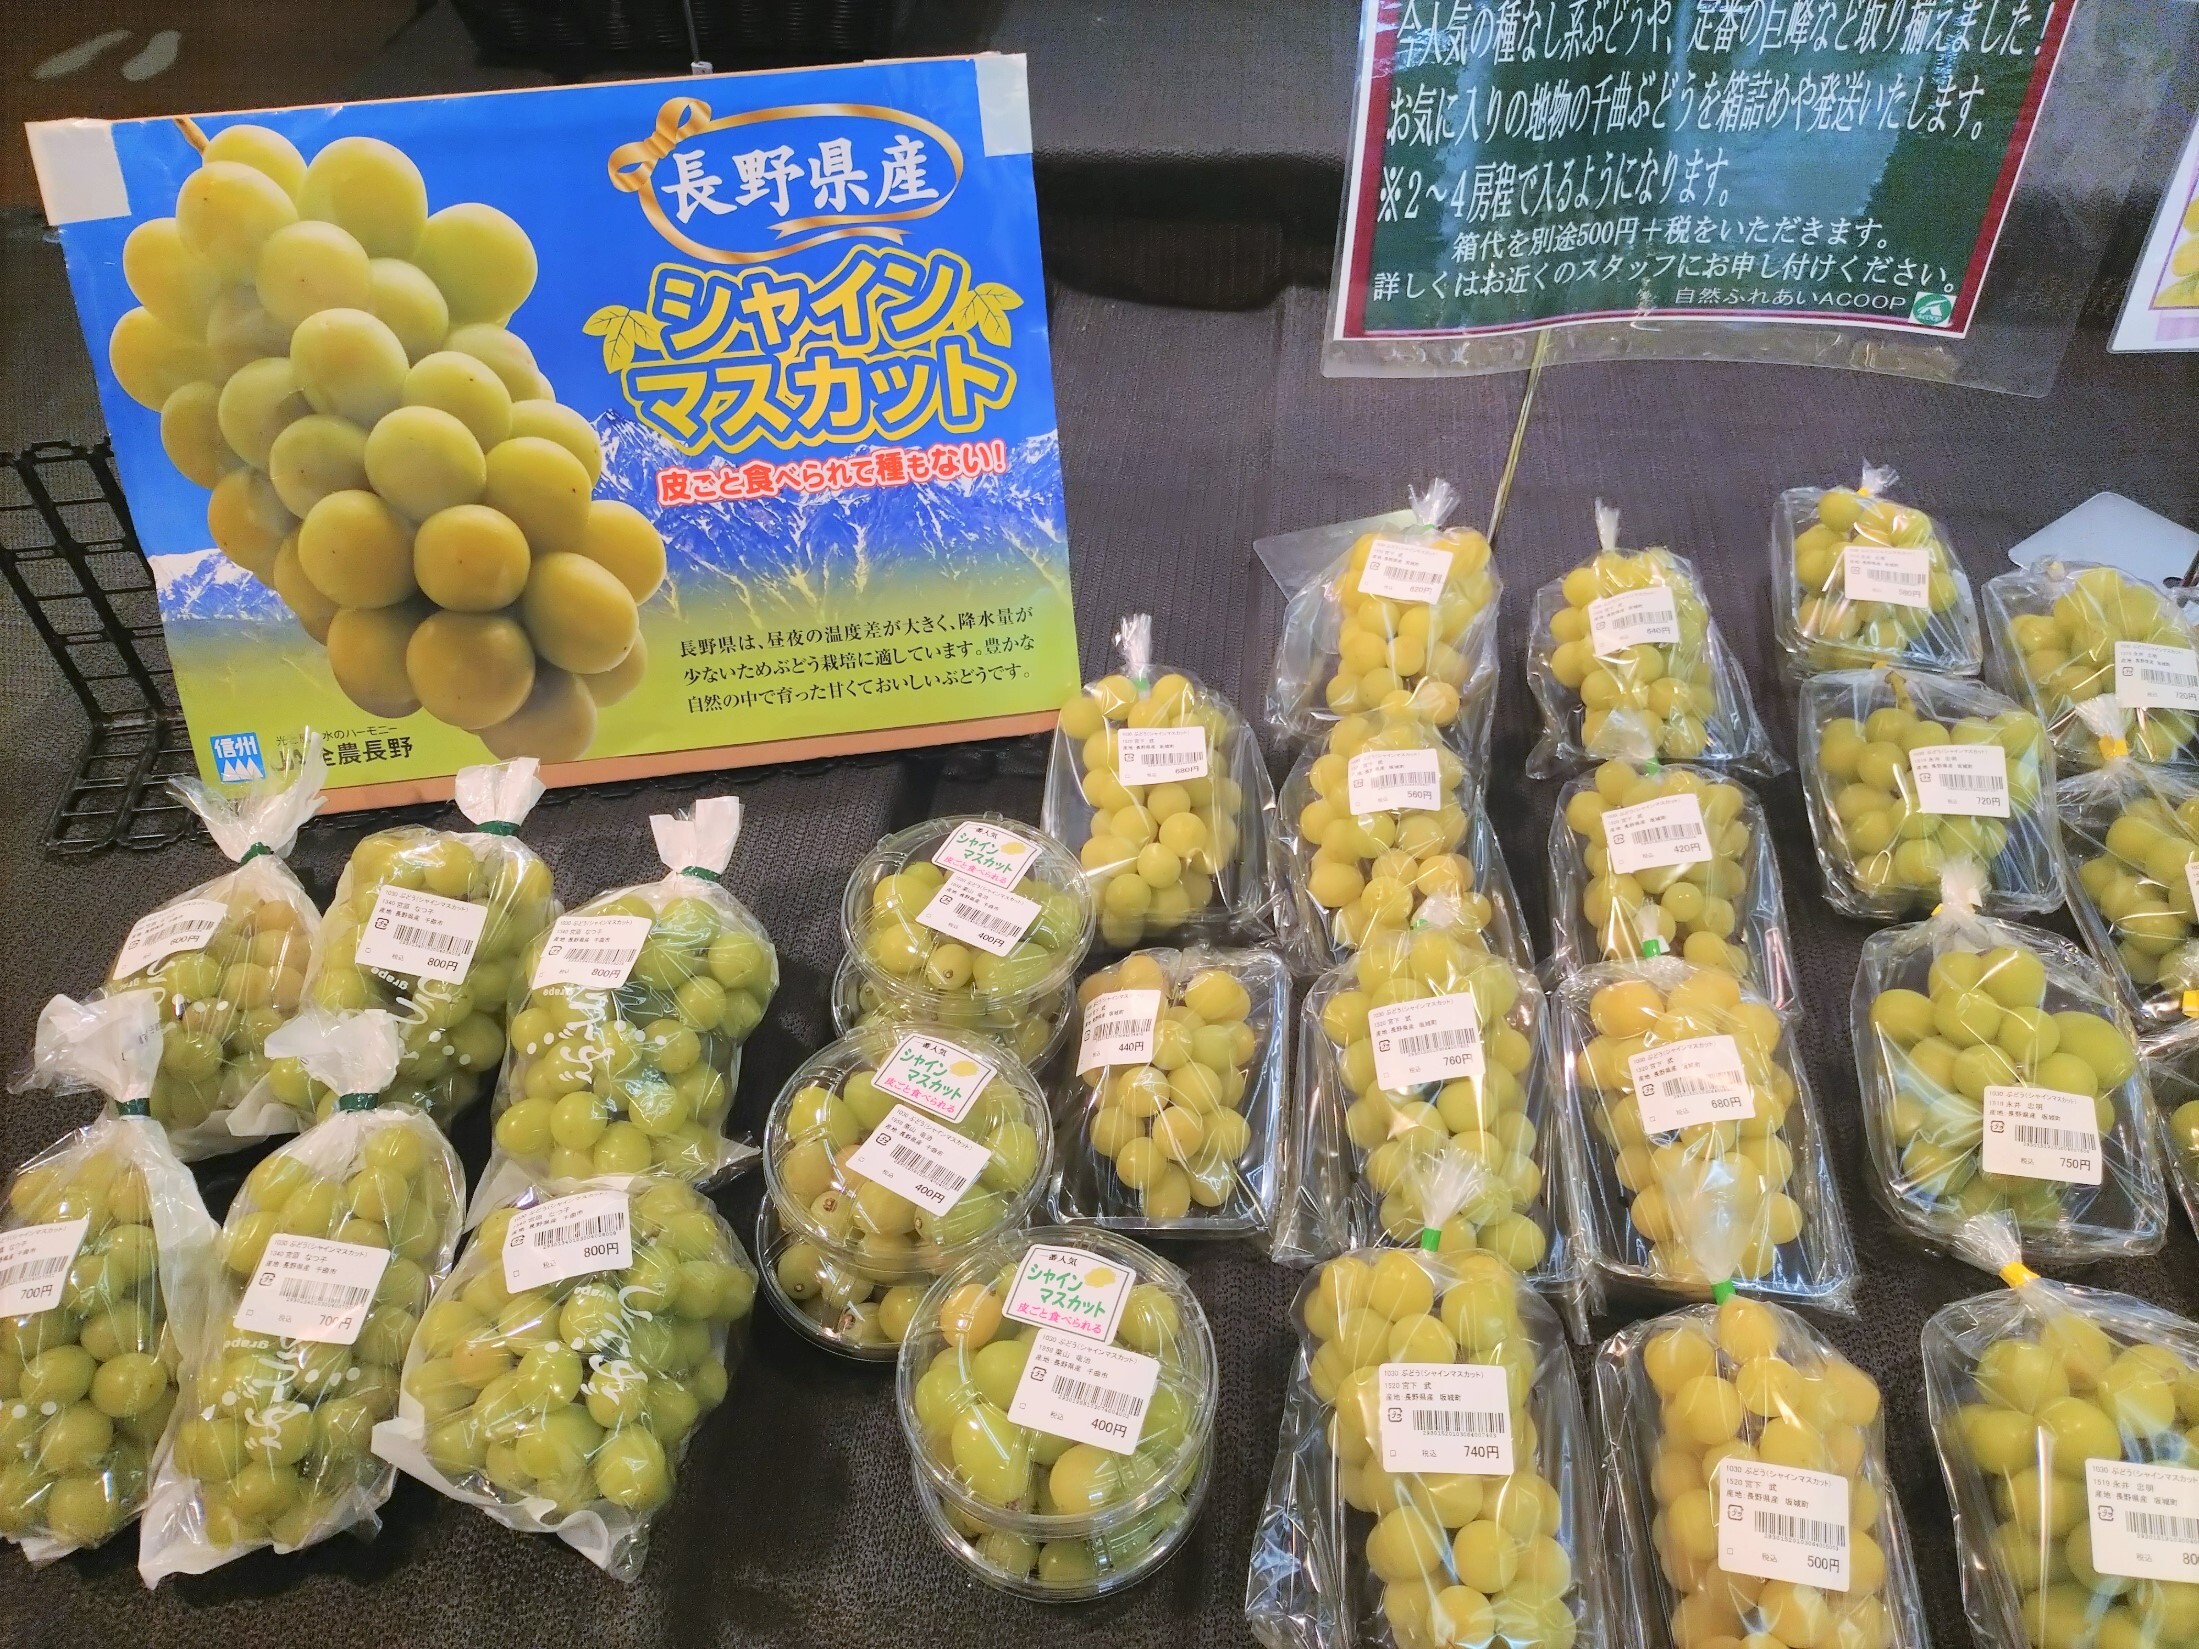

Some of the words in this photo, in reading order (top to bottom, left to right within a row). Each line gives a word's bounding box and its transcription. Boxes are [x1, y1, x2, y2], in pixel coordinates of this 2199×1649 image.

[1387, 68, 1984, 146] お気に入りの地物の千曲ぶどうを箱詰めや発送いたします。
[661, 135, 941, 224] 長野県産
[1373, 251, 1954, 302] 詳しくはお近くのスタッフにお申し付けください。
[655, 249, 962, 355] シャイン
[1675, 287, 1907, 310] 自然ふれあいACOOP
[630, 340, 1008, 447] マスカット
[680, 607, 1034, 658] 長野県は、昼夜の温度差が大きく、降水量が
[684, 634, 1035, 686] 少ないためぶどう栽培に適しています。豊かな
[688, 663, 1032, 713] 自然の中で育った甘くておいしいぶどうです。
[214, 735, 258, 758] 信州
[1407, 791, 1432, 800] 560円
[1976, 797, 2001, 807] 720円
[956, 833, 999, 855] シャイン
[1674, 843, 1701, 853] 420円
[944, 855, 1007, 884] 皮ごと食べられる
[964, 849, 1013, 873] マスカット
[978, 932, 1005, 947] 400円
[427, 957, 459, 971] 800円
[591, 968, 621, 979] 800円
[370, 966, 409, 990] grape
[1119, 1041, 1144, 1052] 440円
[900, 1048, 948, 1077] シャイン
[1442, 1053, 1473, 1066] 760円
[907, 1068, 963, 1100] マスカット
[884, 1077, 955, 1114] 皮ごと食べられる
[1711, 1096, 1742, 1109] 680円
[2060, 1157, 2091, 1171] 750円
[915, 1184, 946, 1203] 400円
[584, 1242, 619, 1257] 800円
[1027, 1263, 1083, 1292] シャイン
[20, 1284, 53, 1299] 700円
[1040, 1287, 1105, 1318] マスカット
[1017, 1302, 1102, 1335] 皮ごと食べられる
[1059, 1337, 1138, 1365] ぶどう(シャインマスカット)
[1401, 1370, 1484, 1379] ぶどう(シャインマスカット)
[1091, 1418, 1128, 1439] 400円
[1422, 1449, 1437, 1458] 税込
[1464, 1445, 1500, 1459] 740円
[1726, 1465, 1742, 1473] 1030
[1744, 1466, 1832, 1488] ぶどう(シャインマスカット)
[2092, 1466, 2109, 1474] 1030
[1726, 1478, 1743, 1486] 1520
[2113, 1481, 2130, 1490] 永井
[1762, 1552, 1778, 1563] 税込
[1807, 1555, 1840, 1574] 500円
